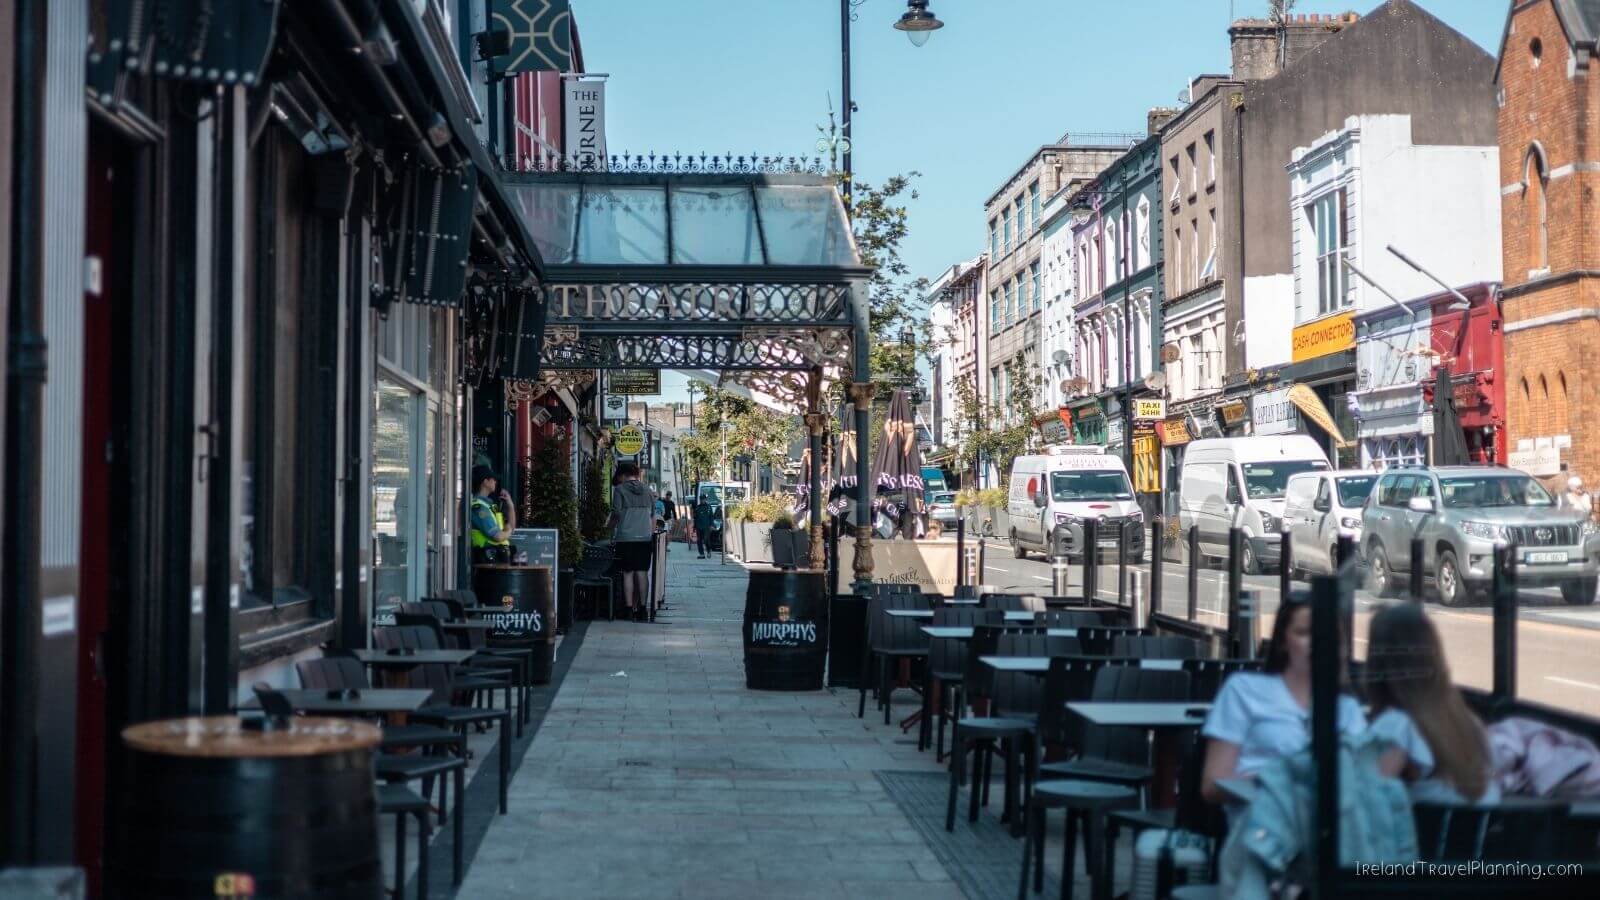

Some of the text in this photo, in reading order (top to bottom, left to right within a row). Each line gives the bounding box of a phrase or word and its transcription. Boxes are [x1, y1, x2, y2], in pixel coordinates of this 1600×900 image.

[572, 90, 599, 101] THE
[551, 284, 771, 319] THEATRE
[1293, 321, 1354, 351] CASH CONNECTORS
[752, 620, 817, 642] MURPHY'S
